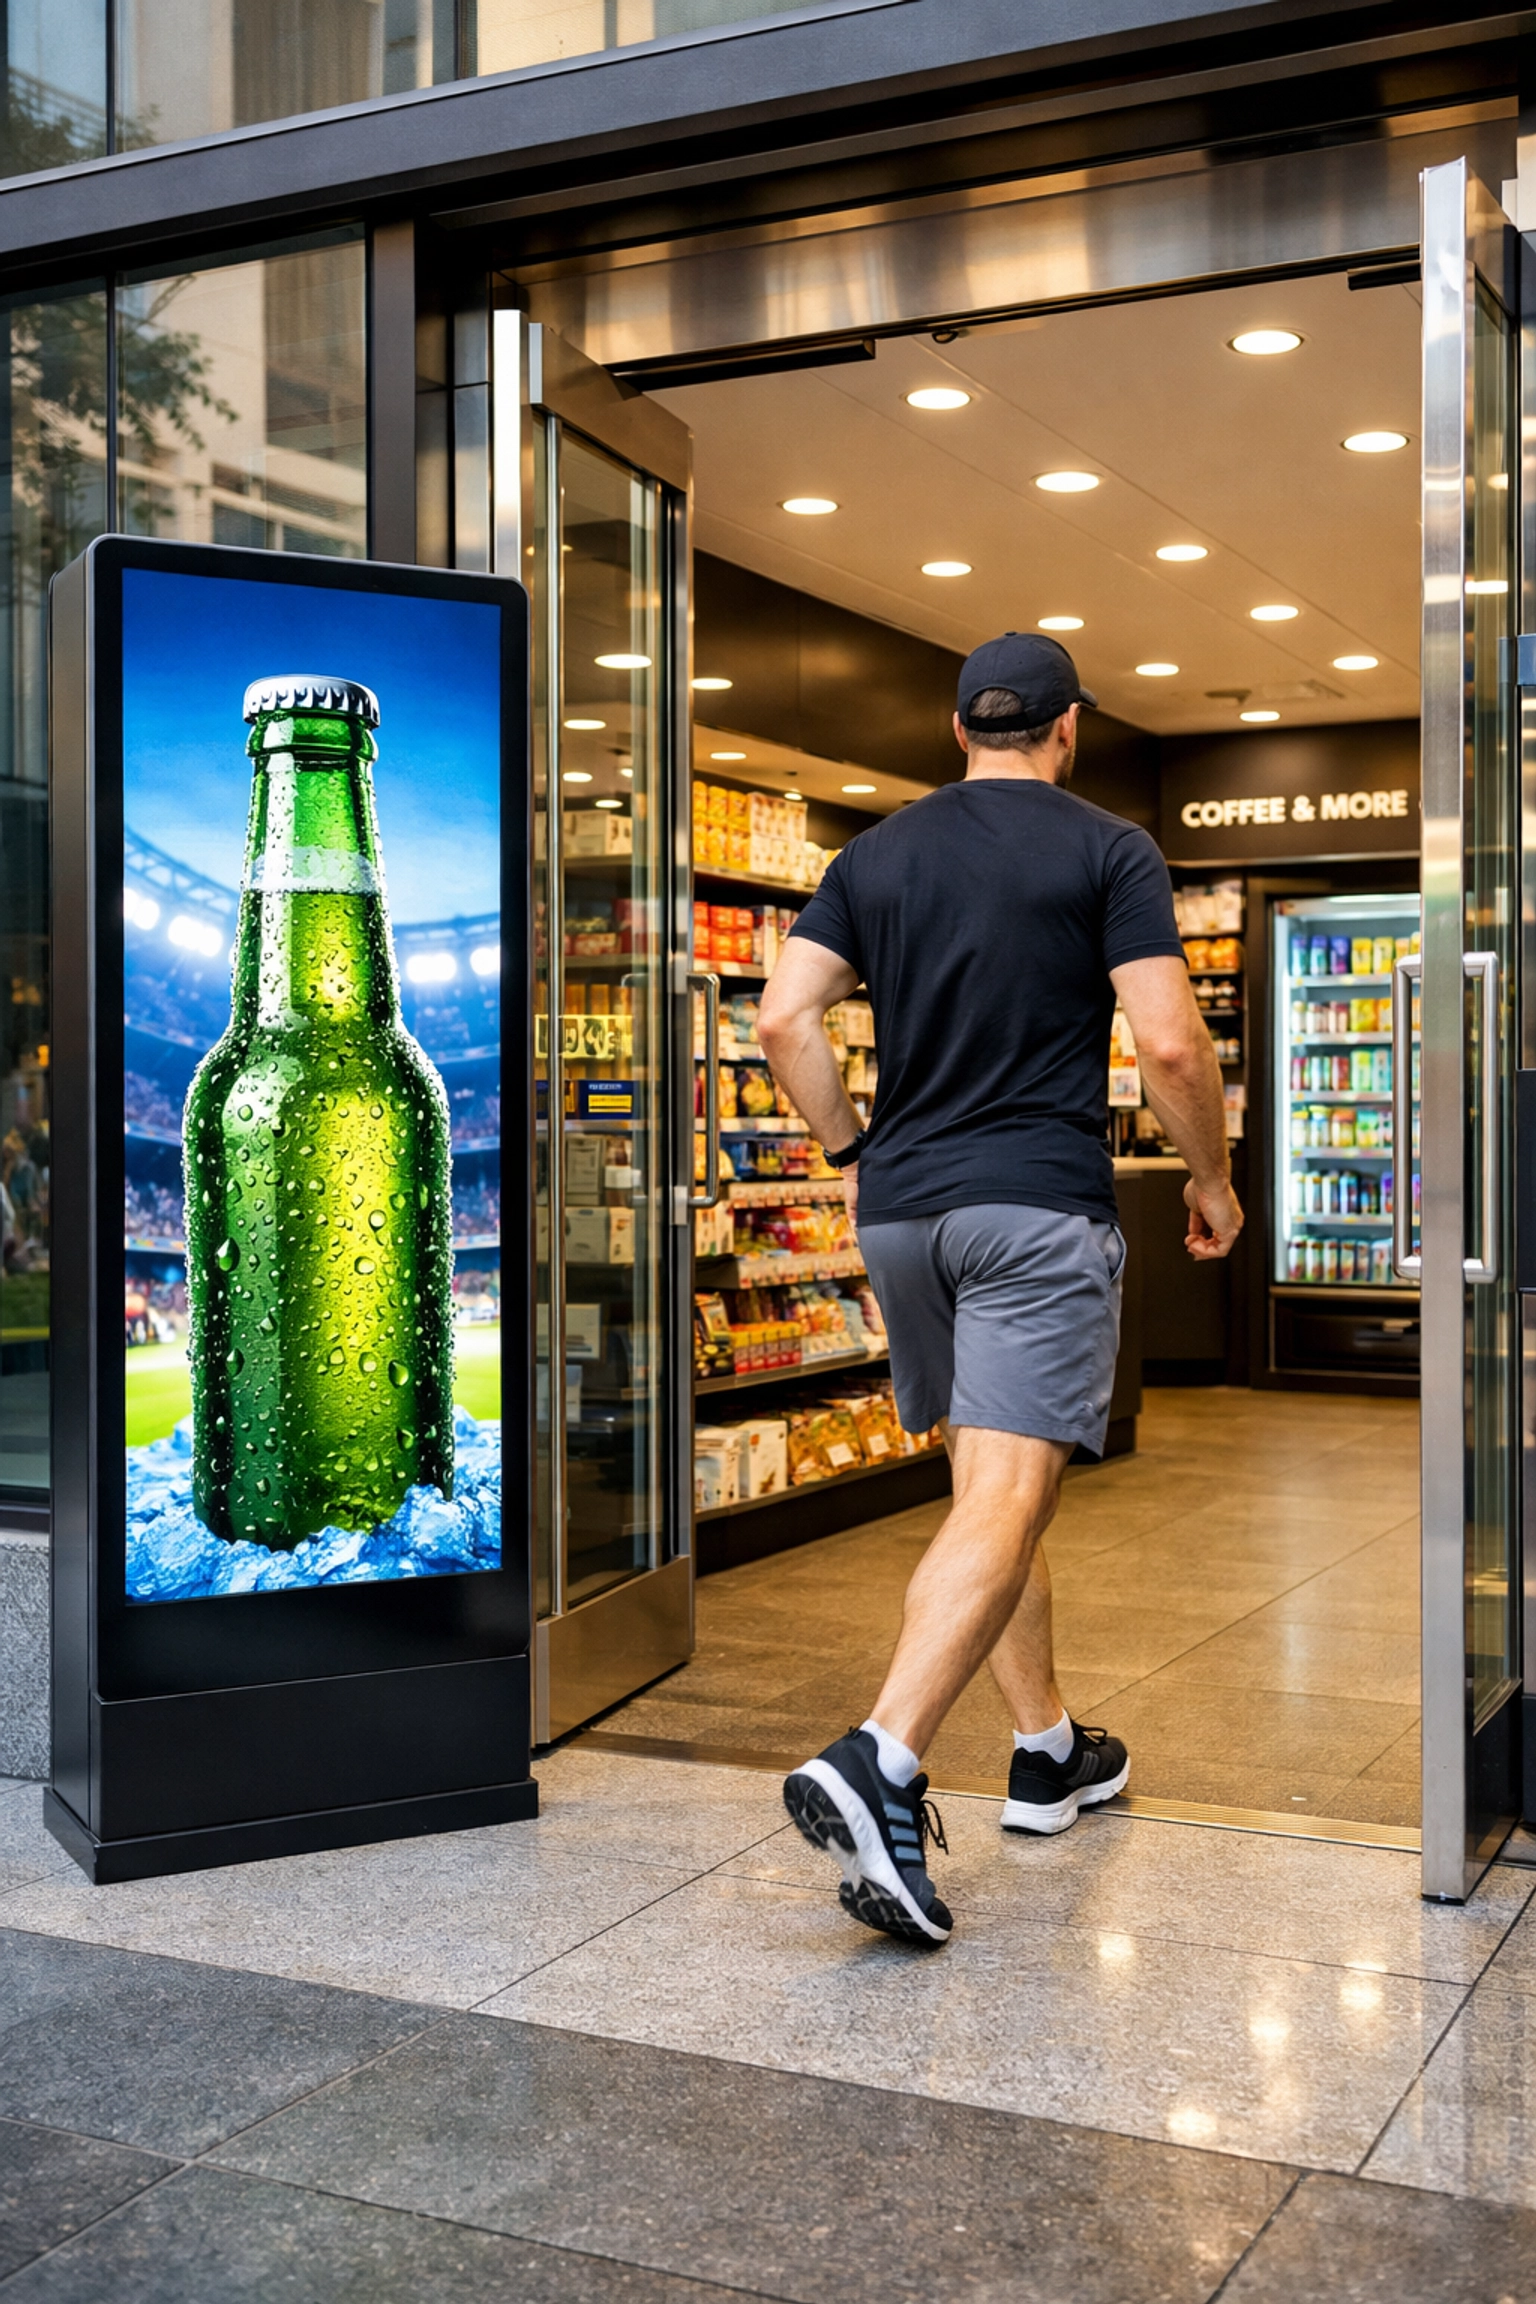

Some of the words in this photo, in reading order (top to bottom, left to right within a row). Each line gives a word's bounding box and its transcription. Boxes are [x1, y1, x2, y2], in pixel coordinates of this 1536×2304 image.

[1181, 797, 1286, 828] COFFEE
[1291, 795, 1316, 822] &
[1320, 789, 1408, 820] MORE
